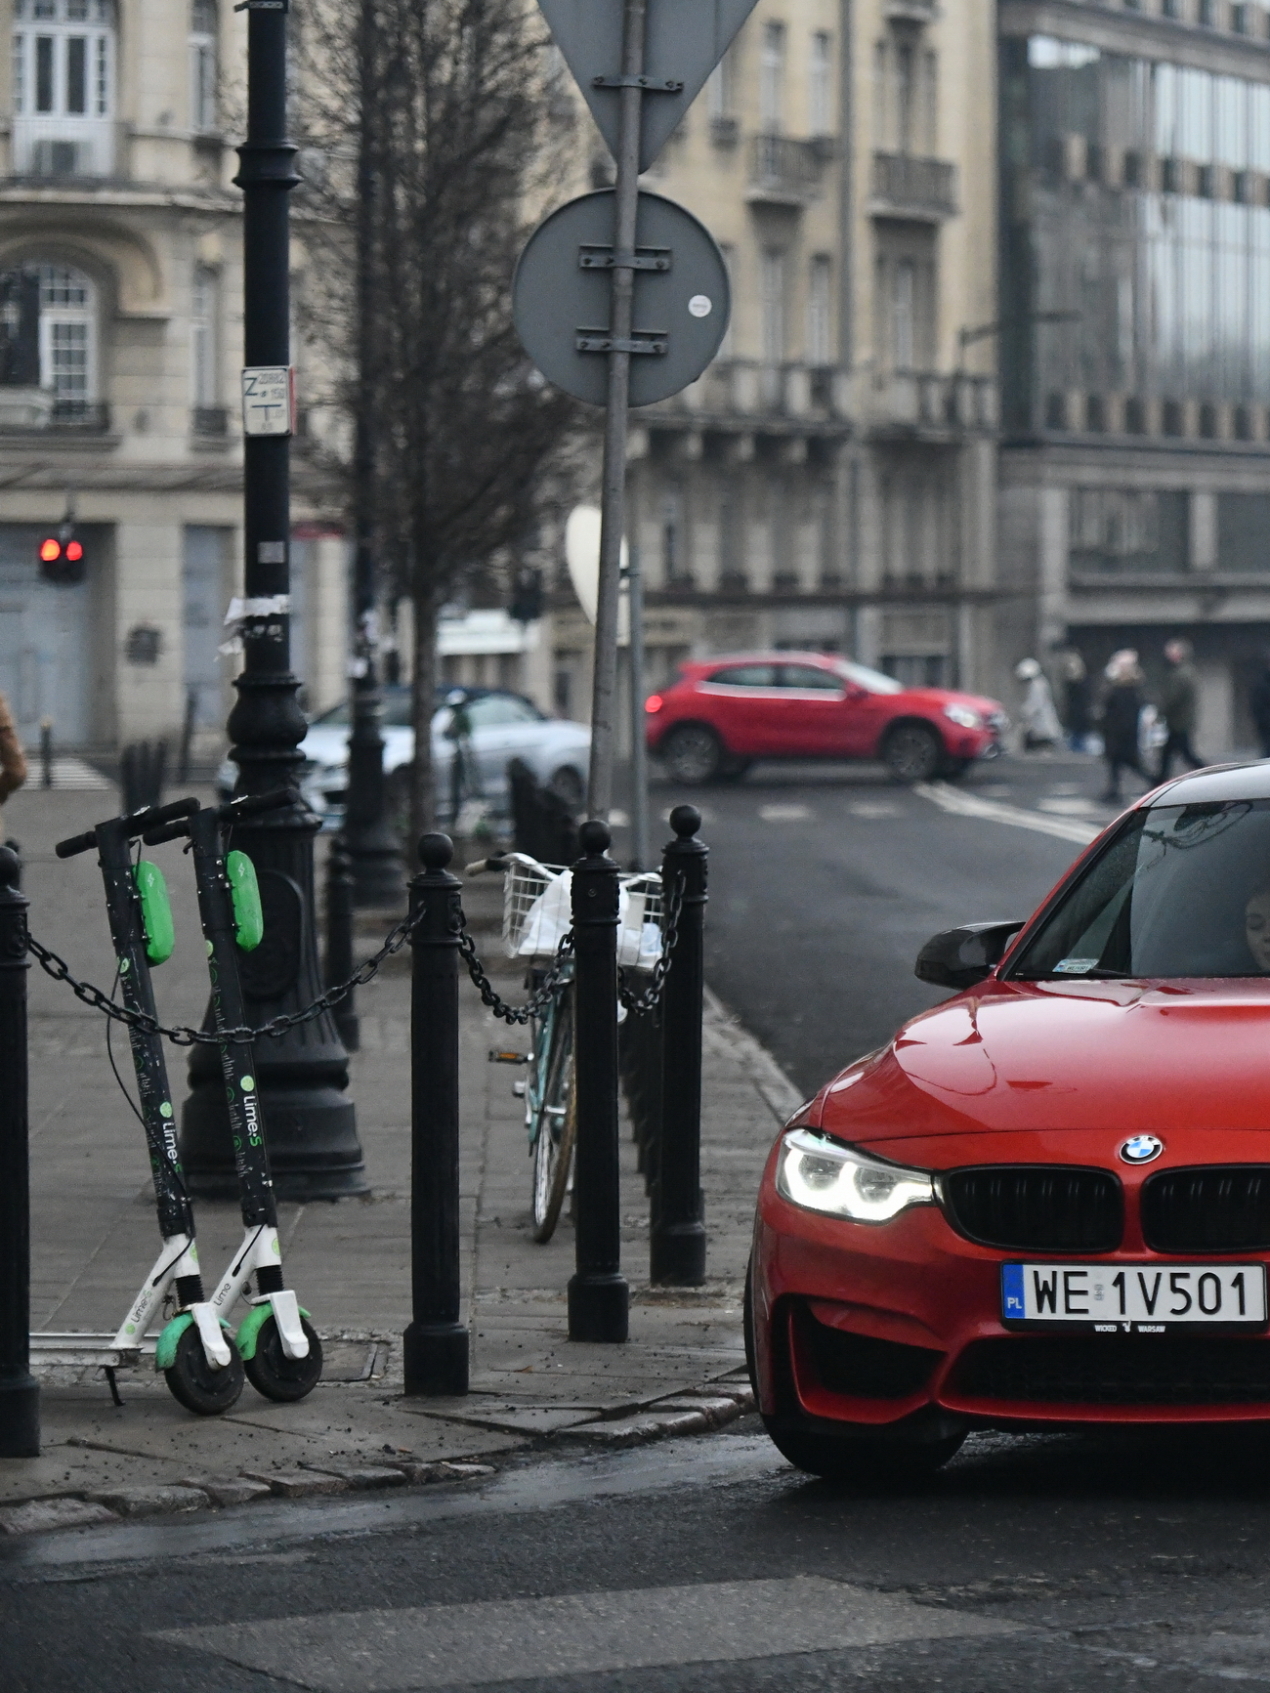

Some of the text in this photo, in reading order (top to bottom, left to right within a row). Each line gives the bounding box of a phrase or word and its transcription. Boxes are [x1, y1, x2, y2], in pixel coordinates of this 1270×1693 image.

[213, 1283, 232, 1306] Lime
[1033, 1270, 1246, 1317] WE 1V501
[1007, 1297, 1023, 1310] PL
[1137, 1325, 1167, 1333] WARSAW
